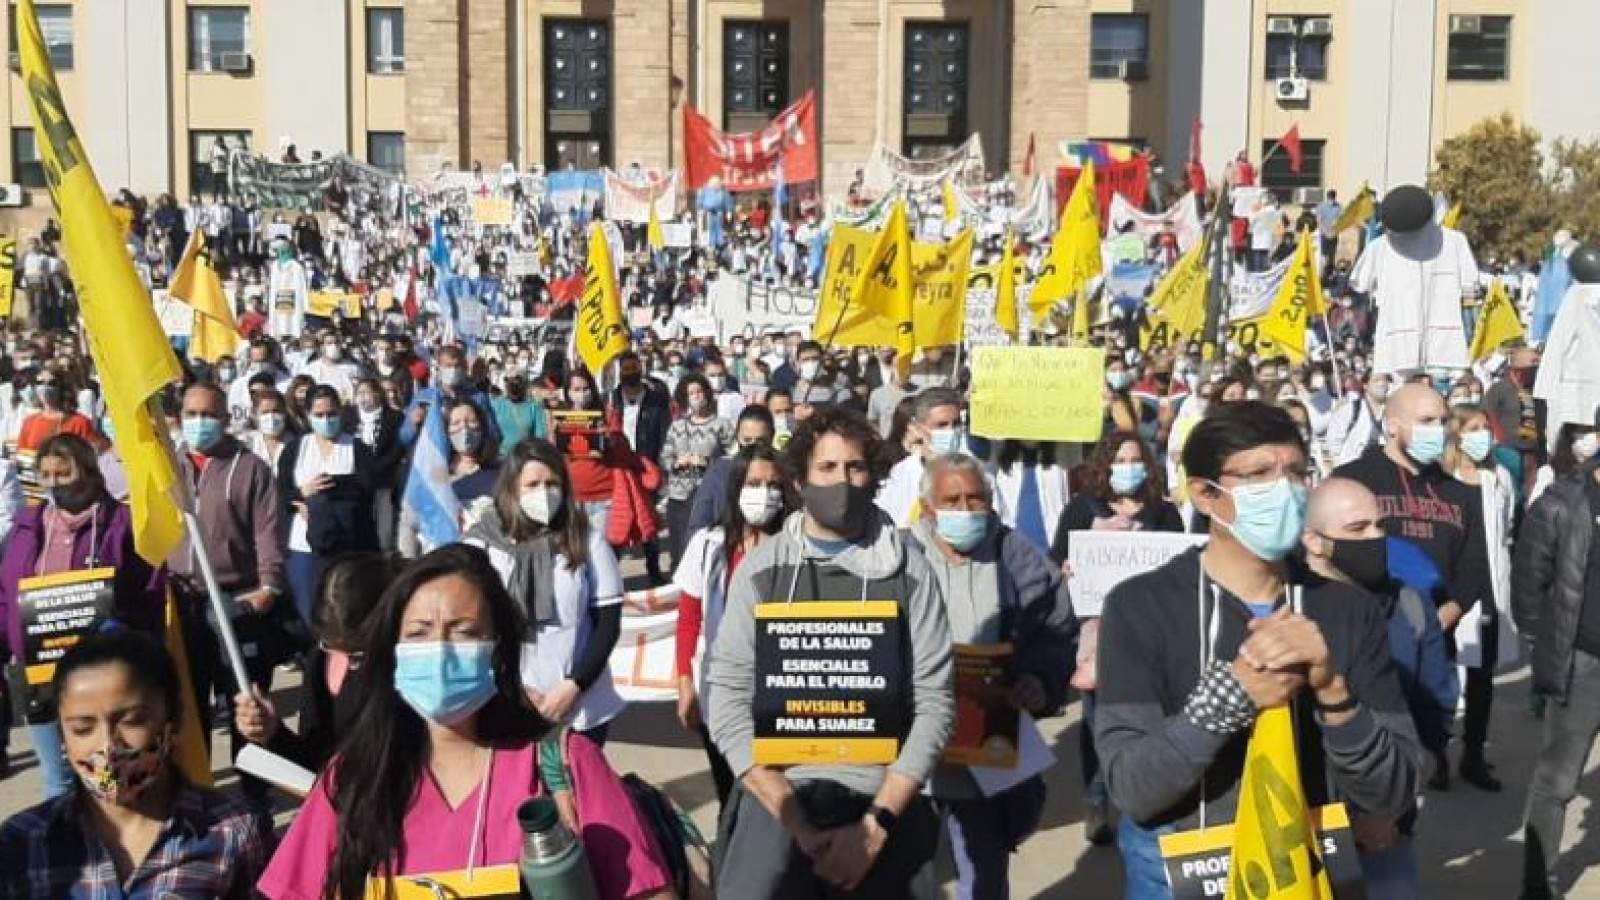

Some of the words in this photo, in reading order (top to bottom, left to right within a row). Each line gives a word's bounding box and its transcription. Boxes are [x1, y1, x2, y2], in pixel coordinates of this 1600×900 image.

[767, 622, 885, 635] PROFESIONALES
[779, 637, 799, 650] DE
[801, 637, 821, 650] LA
[822, 637, 873, 650] SALUD
[782, 659, 870, 673] ESENCIALES
[765, 675, 807, 689] PARA
[807, 675, 827, 688] EL
[827, 675, 887, 689] PUEBLO
[785, 699, 867, 714] INVISIBLES
[775, 718, 816, 732] PARA
[816, 718, 876, 732] SUAREZ
